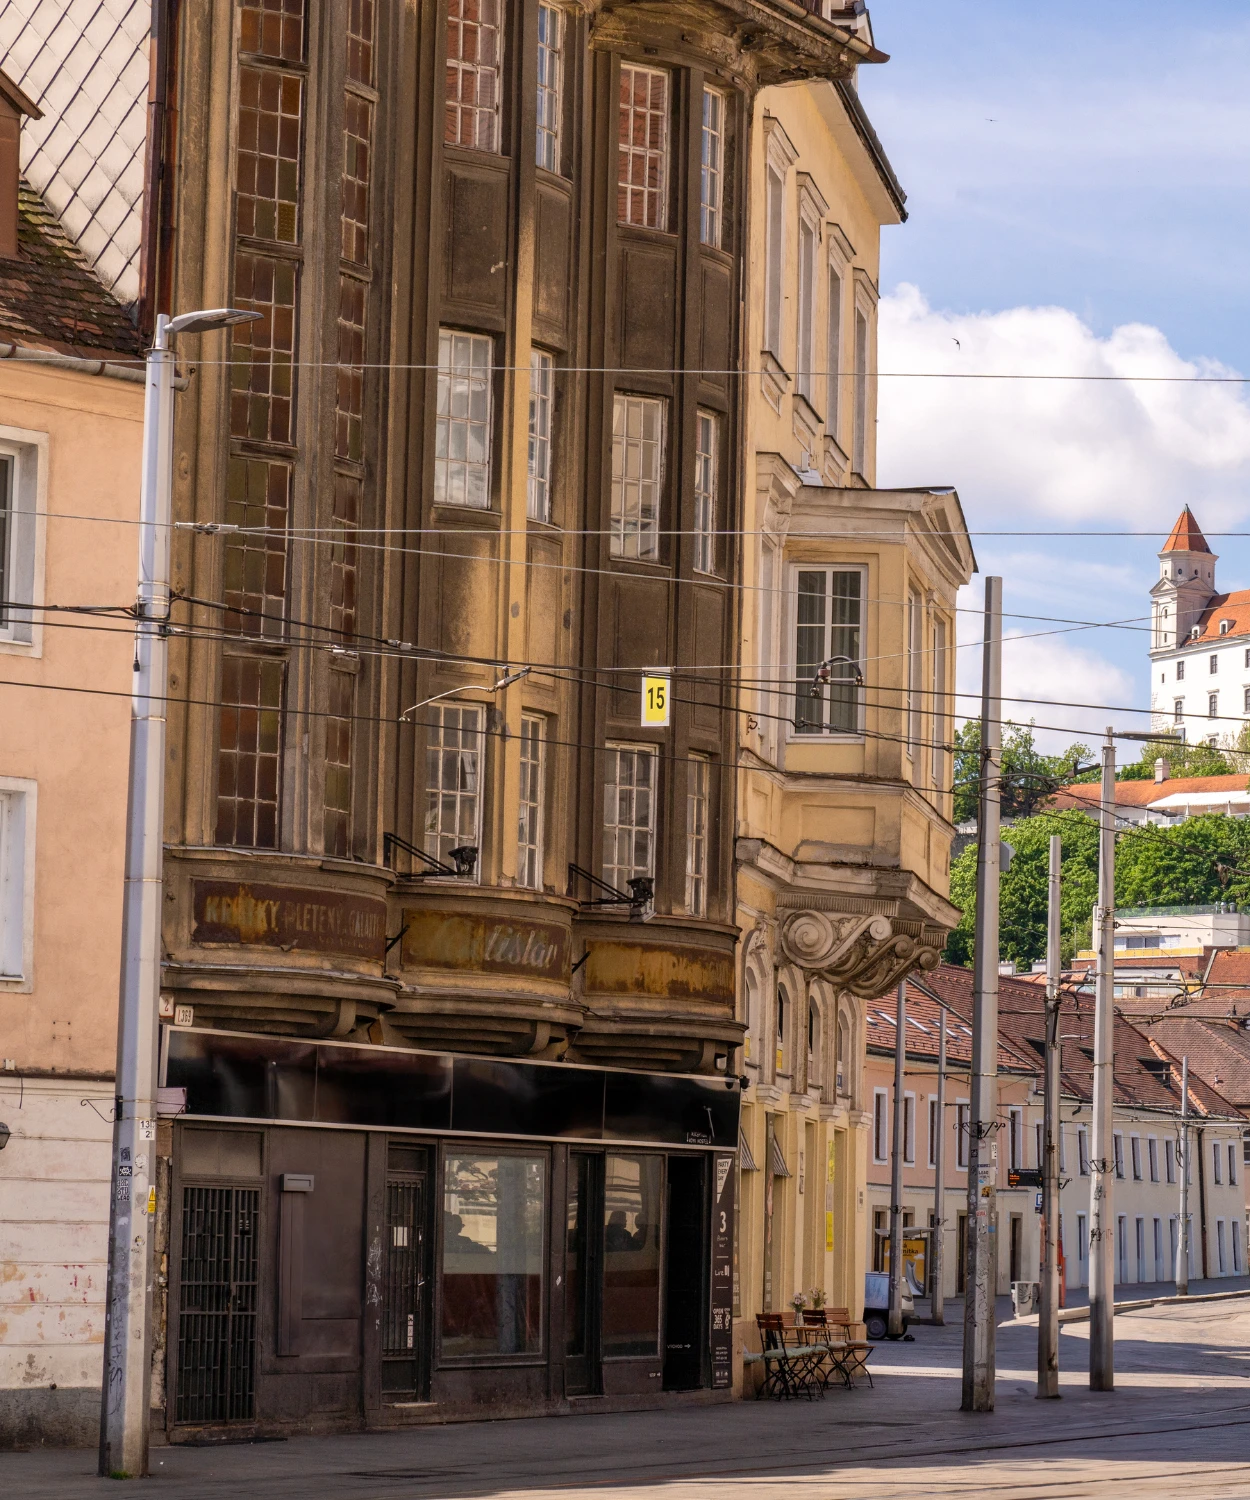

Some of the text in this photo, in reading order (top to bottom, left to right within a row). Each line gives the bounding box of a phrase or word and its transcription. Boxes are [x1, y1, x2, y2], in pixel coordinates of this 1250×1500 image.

[647, 687, 665, 709] 15
[164, 998, 170, 1012] 2
[719, 1211, 727, 1233] 3
